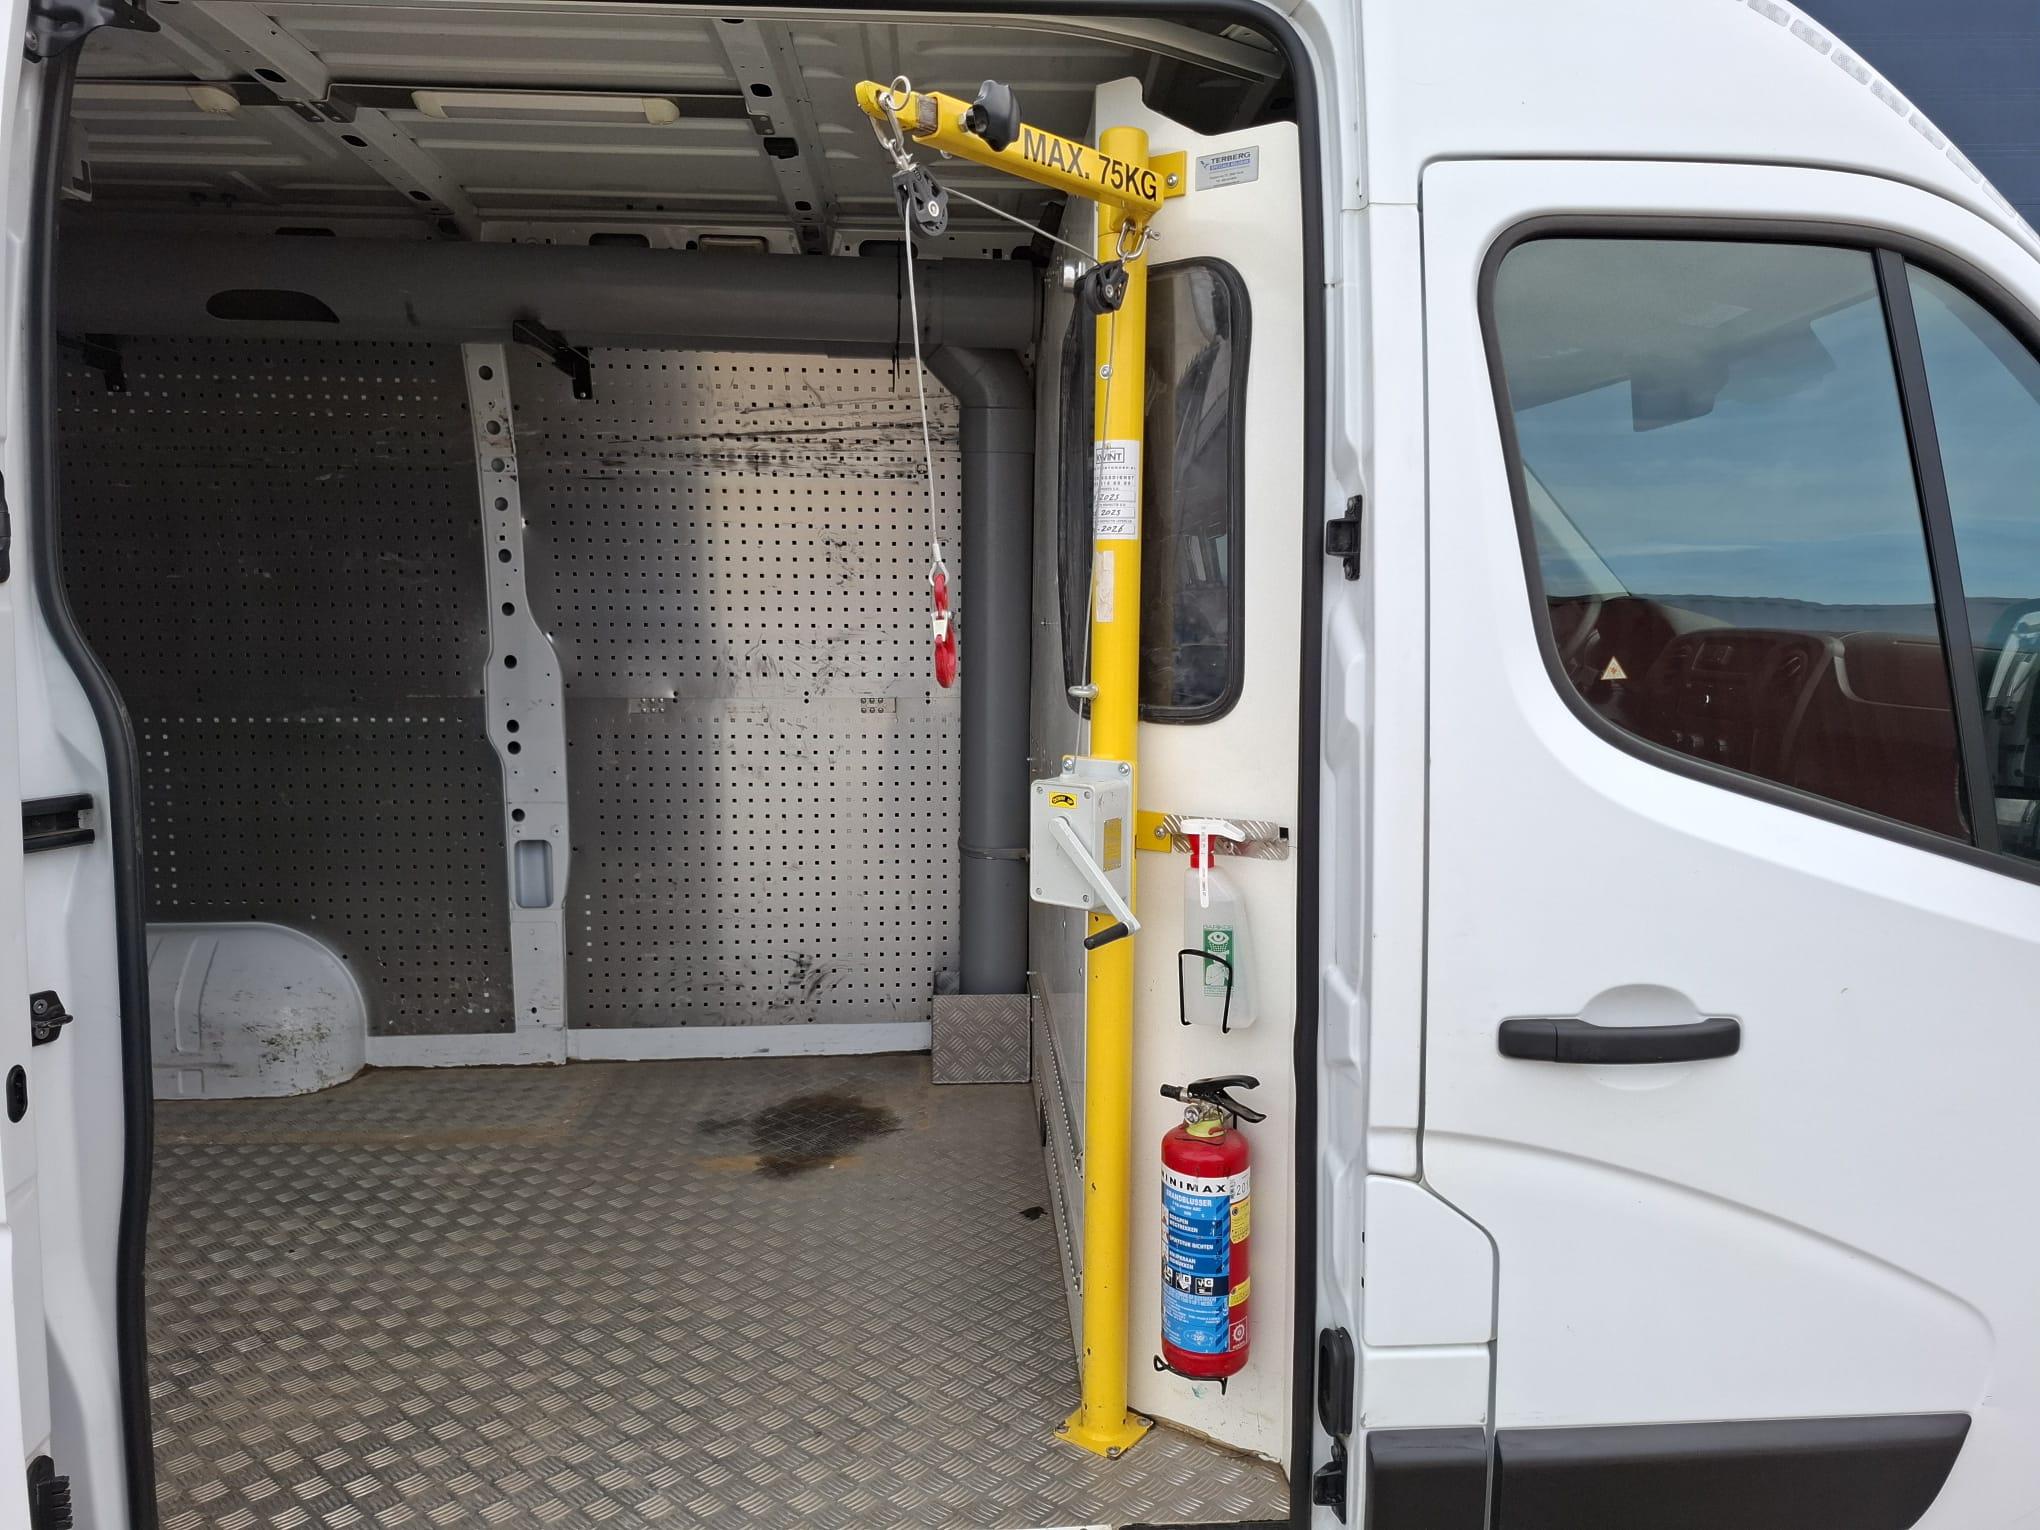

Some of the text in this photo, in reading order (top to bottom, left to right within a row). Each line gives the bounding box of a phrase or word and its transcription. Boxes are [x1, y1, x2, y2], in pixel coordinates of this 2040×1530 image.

[1024, 128, 1157, 202] MAX. 75KG
[1211, 152, 1251, 164] TERBERG
